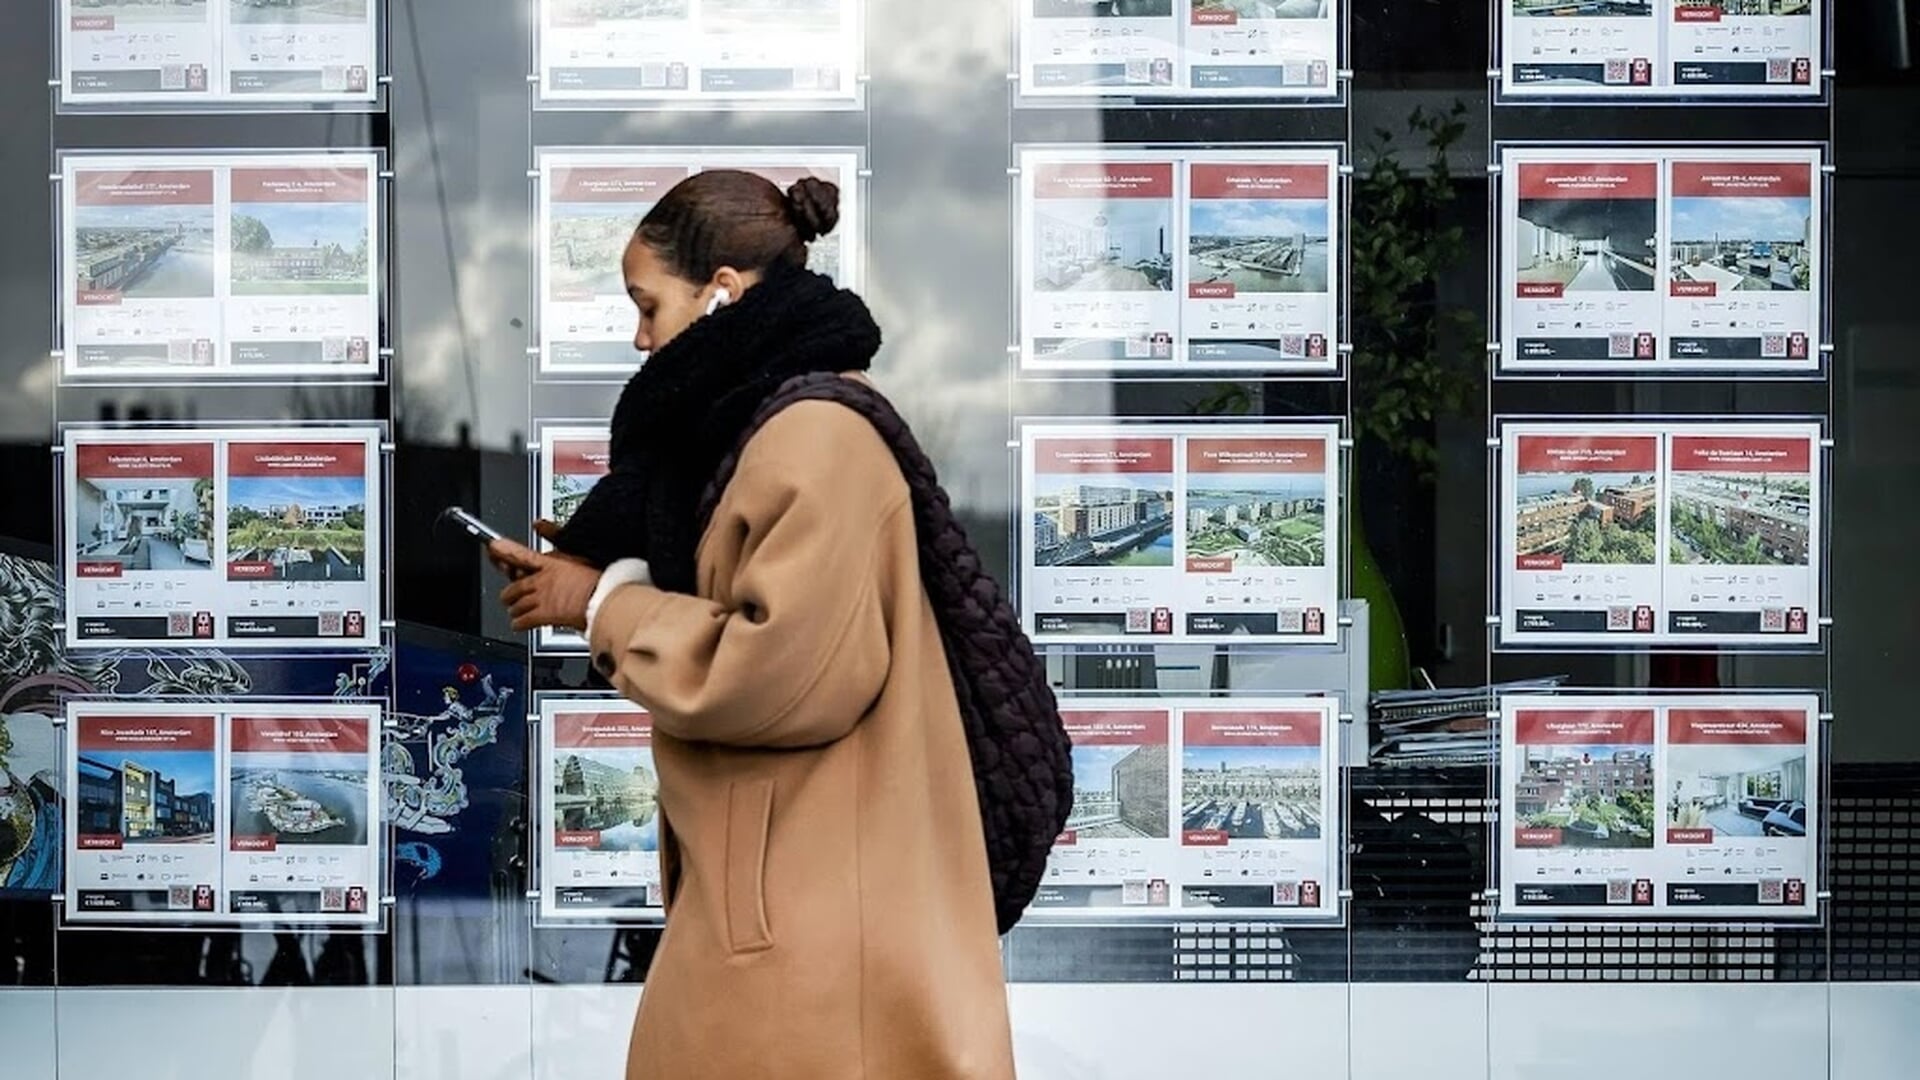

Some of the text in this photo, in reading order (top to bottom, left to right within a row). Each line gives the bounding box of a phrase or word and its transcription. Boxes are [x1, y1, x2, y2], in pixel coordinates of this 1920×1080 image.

[1198, 14, 1230, 22] VERKOCHT
[1595, 175, 1628, 183] Amsterdam
[1195, 287, 1227, 295] VERKOCHT
[1118, 451, 1151, 459] Amsterdam
[1192, 561, 1225, 569] VERKOCHT
[1523, 559, 1555, 567] VERKOCHT
[158, 728, 191, 736] Amsterdam
